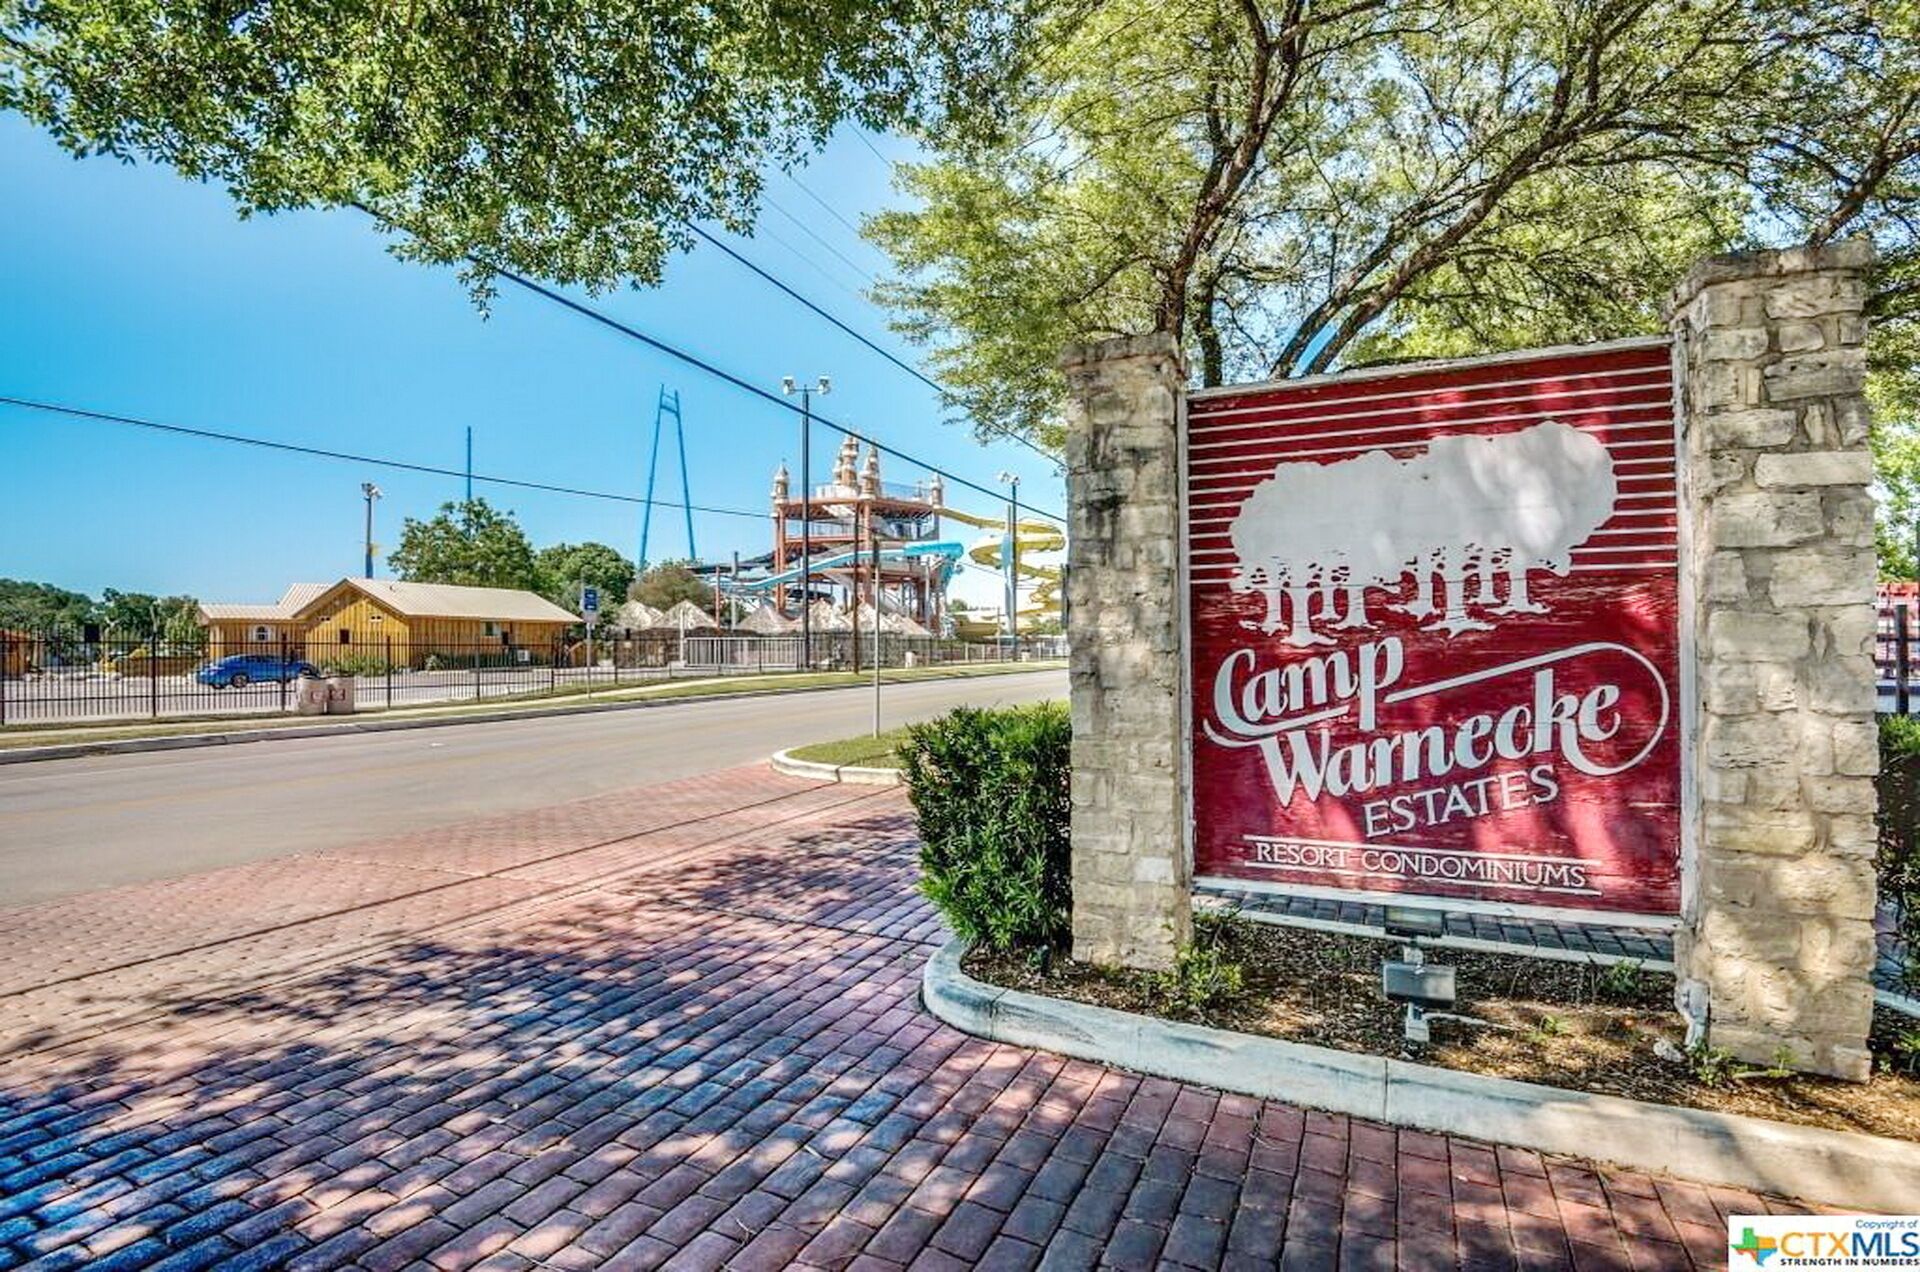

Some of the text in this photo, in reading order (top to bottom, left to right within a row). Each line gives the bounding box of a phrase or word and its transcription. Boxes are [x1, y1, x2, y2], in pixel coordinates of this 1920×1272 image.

[1213, 636, 1404, 736] Camp
[1259, 668, 1622, 808] Warnecke
[1363, 764, 1559, 838] ESTATES
[1256, 842, 1586, 888] RESORT CONDOMINIUMS
